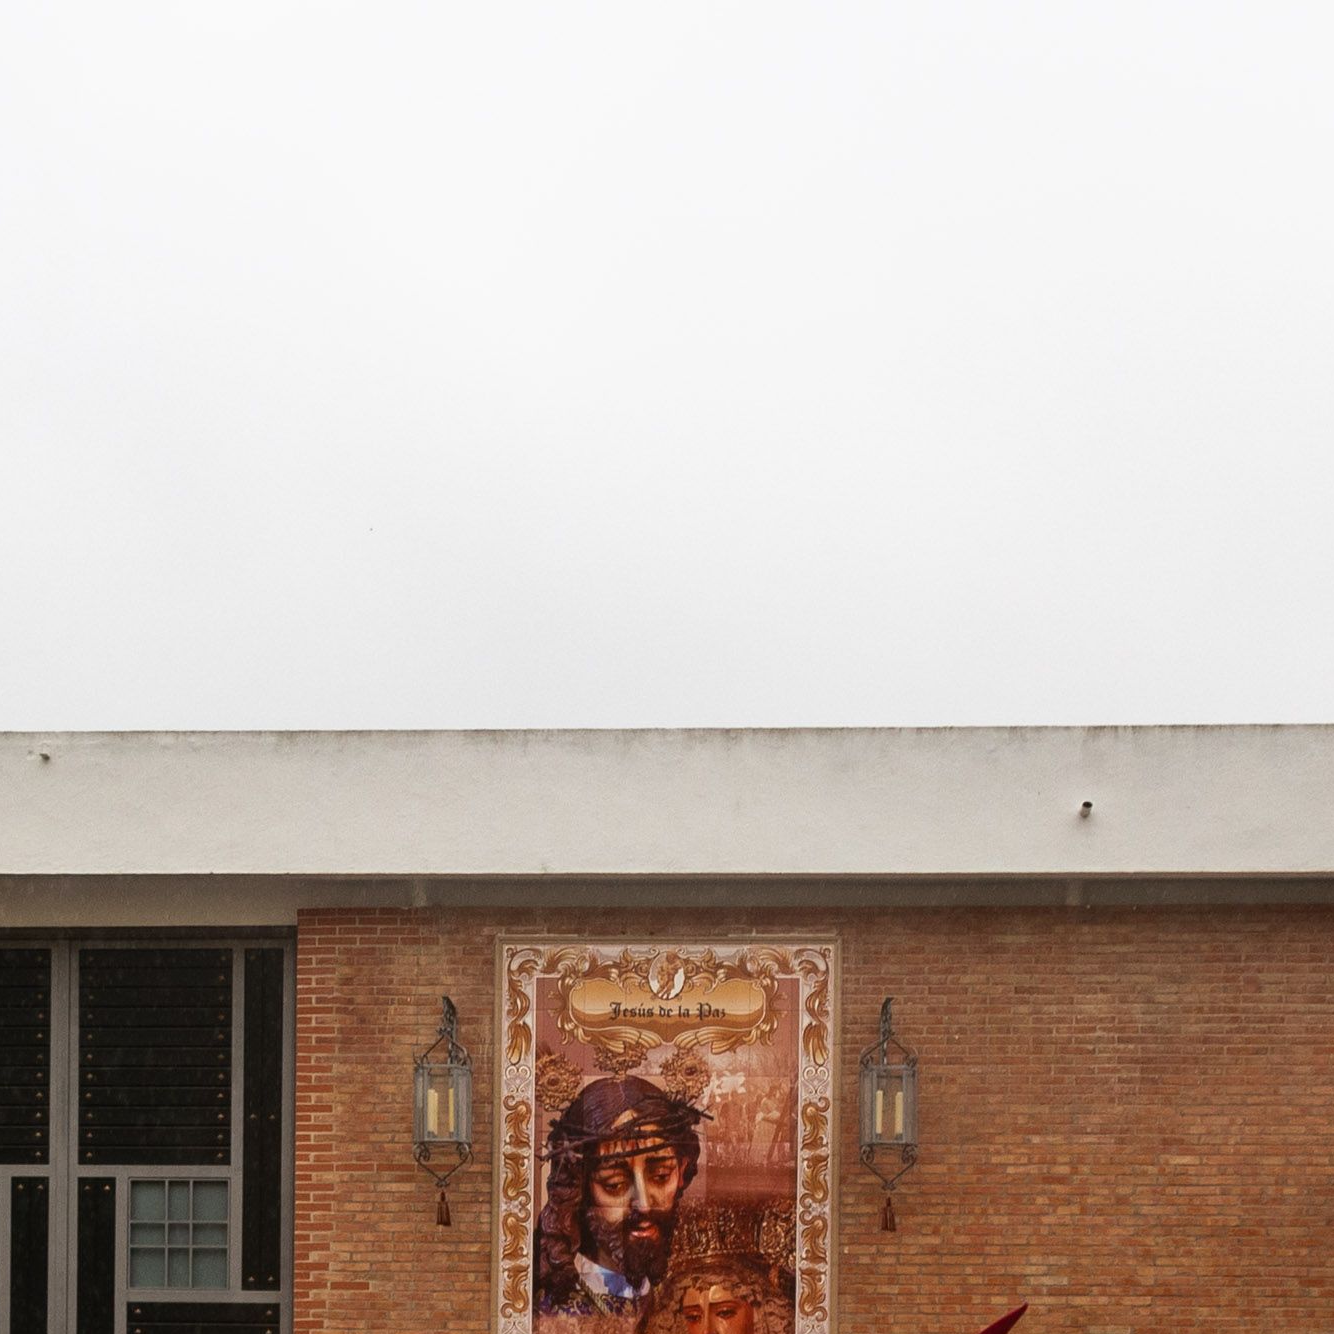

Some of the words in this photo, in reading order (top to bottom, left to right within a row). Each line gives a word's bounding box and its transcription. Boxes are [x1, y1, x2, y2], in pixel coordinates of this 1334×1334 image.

[609, 1001, 654, 1020] Jesús
[658, 1004, 673, 1018] de
[678, 1005, 690, 1018] la
